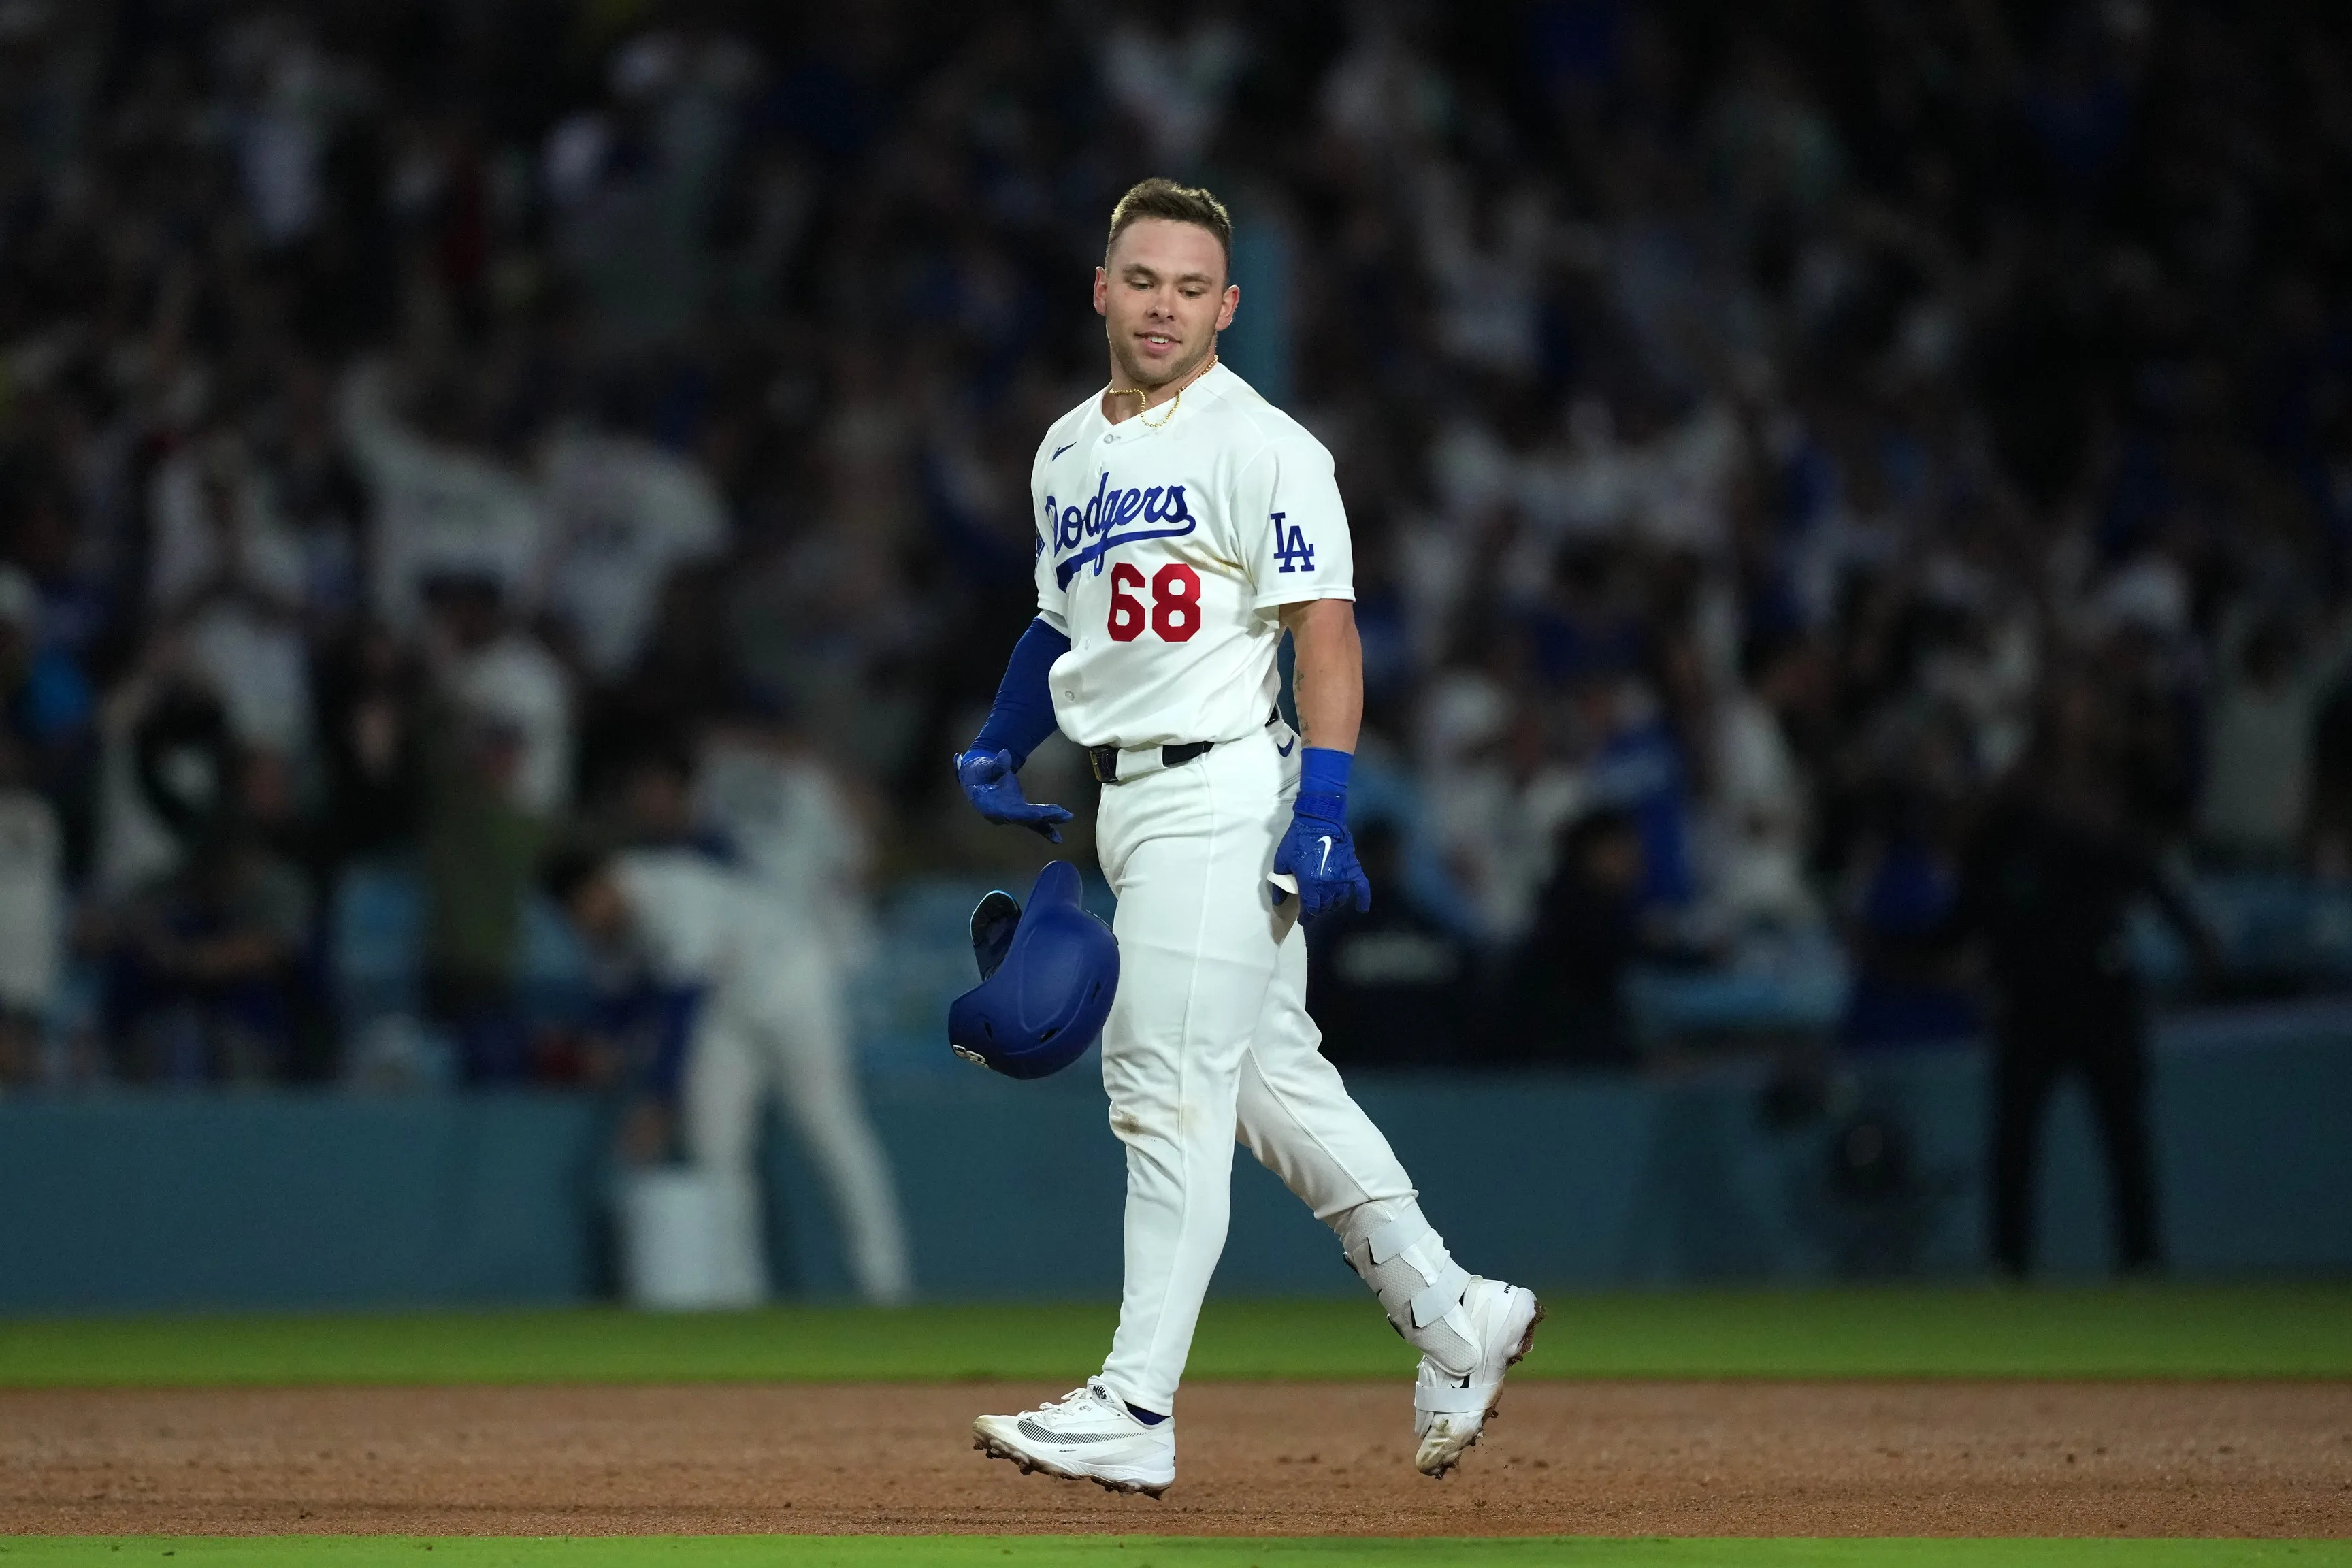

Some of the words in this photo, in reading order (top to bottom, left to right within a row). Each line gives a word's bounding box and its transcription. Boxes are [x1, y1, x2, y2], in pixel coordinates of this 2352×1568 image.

[1045, 472, 1189, 576] Dodgers
[1270, 512, 1315, 573] LA
[1107, 562, 1201, 642] 68
